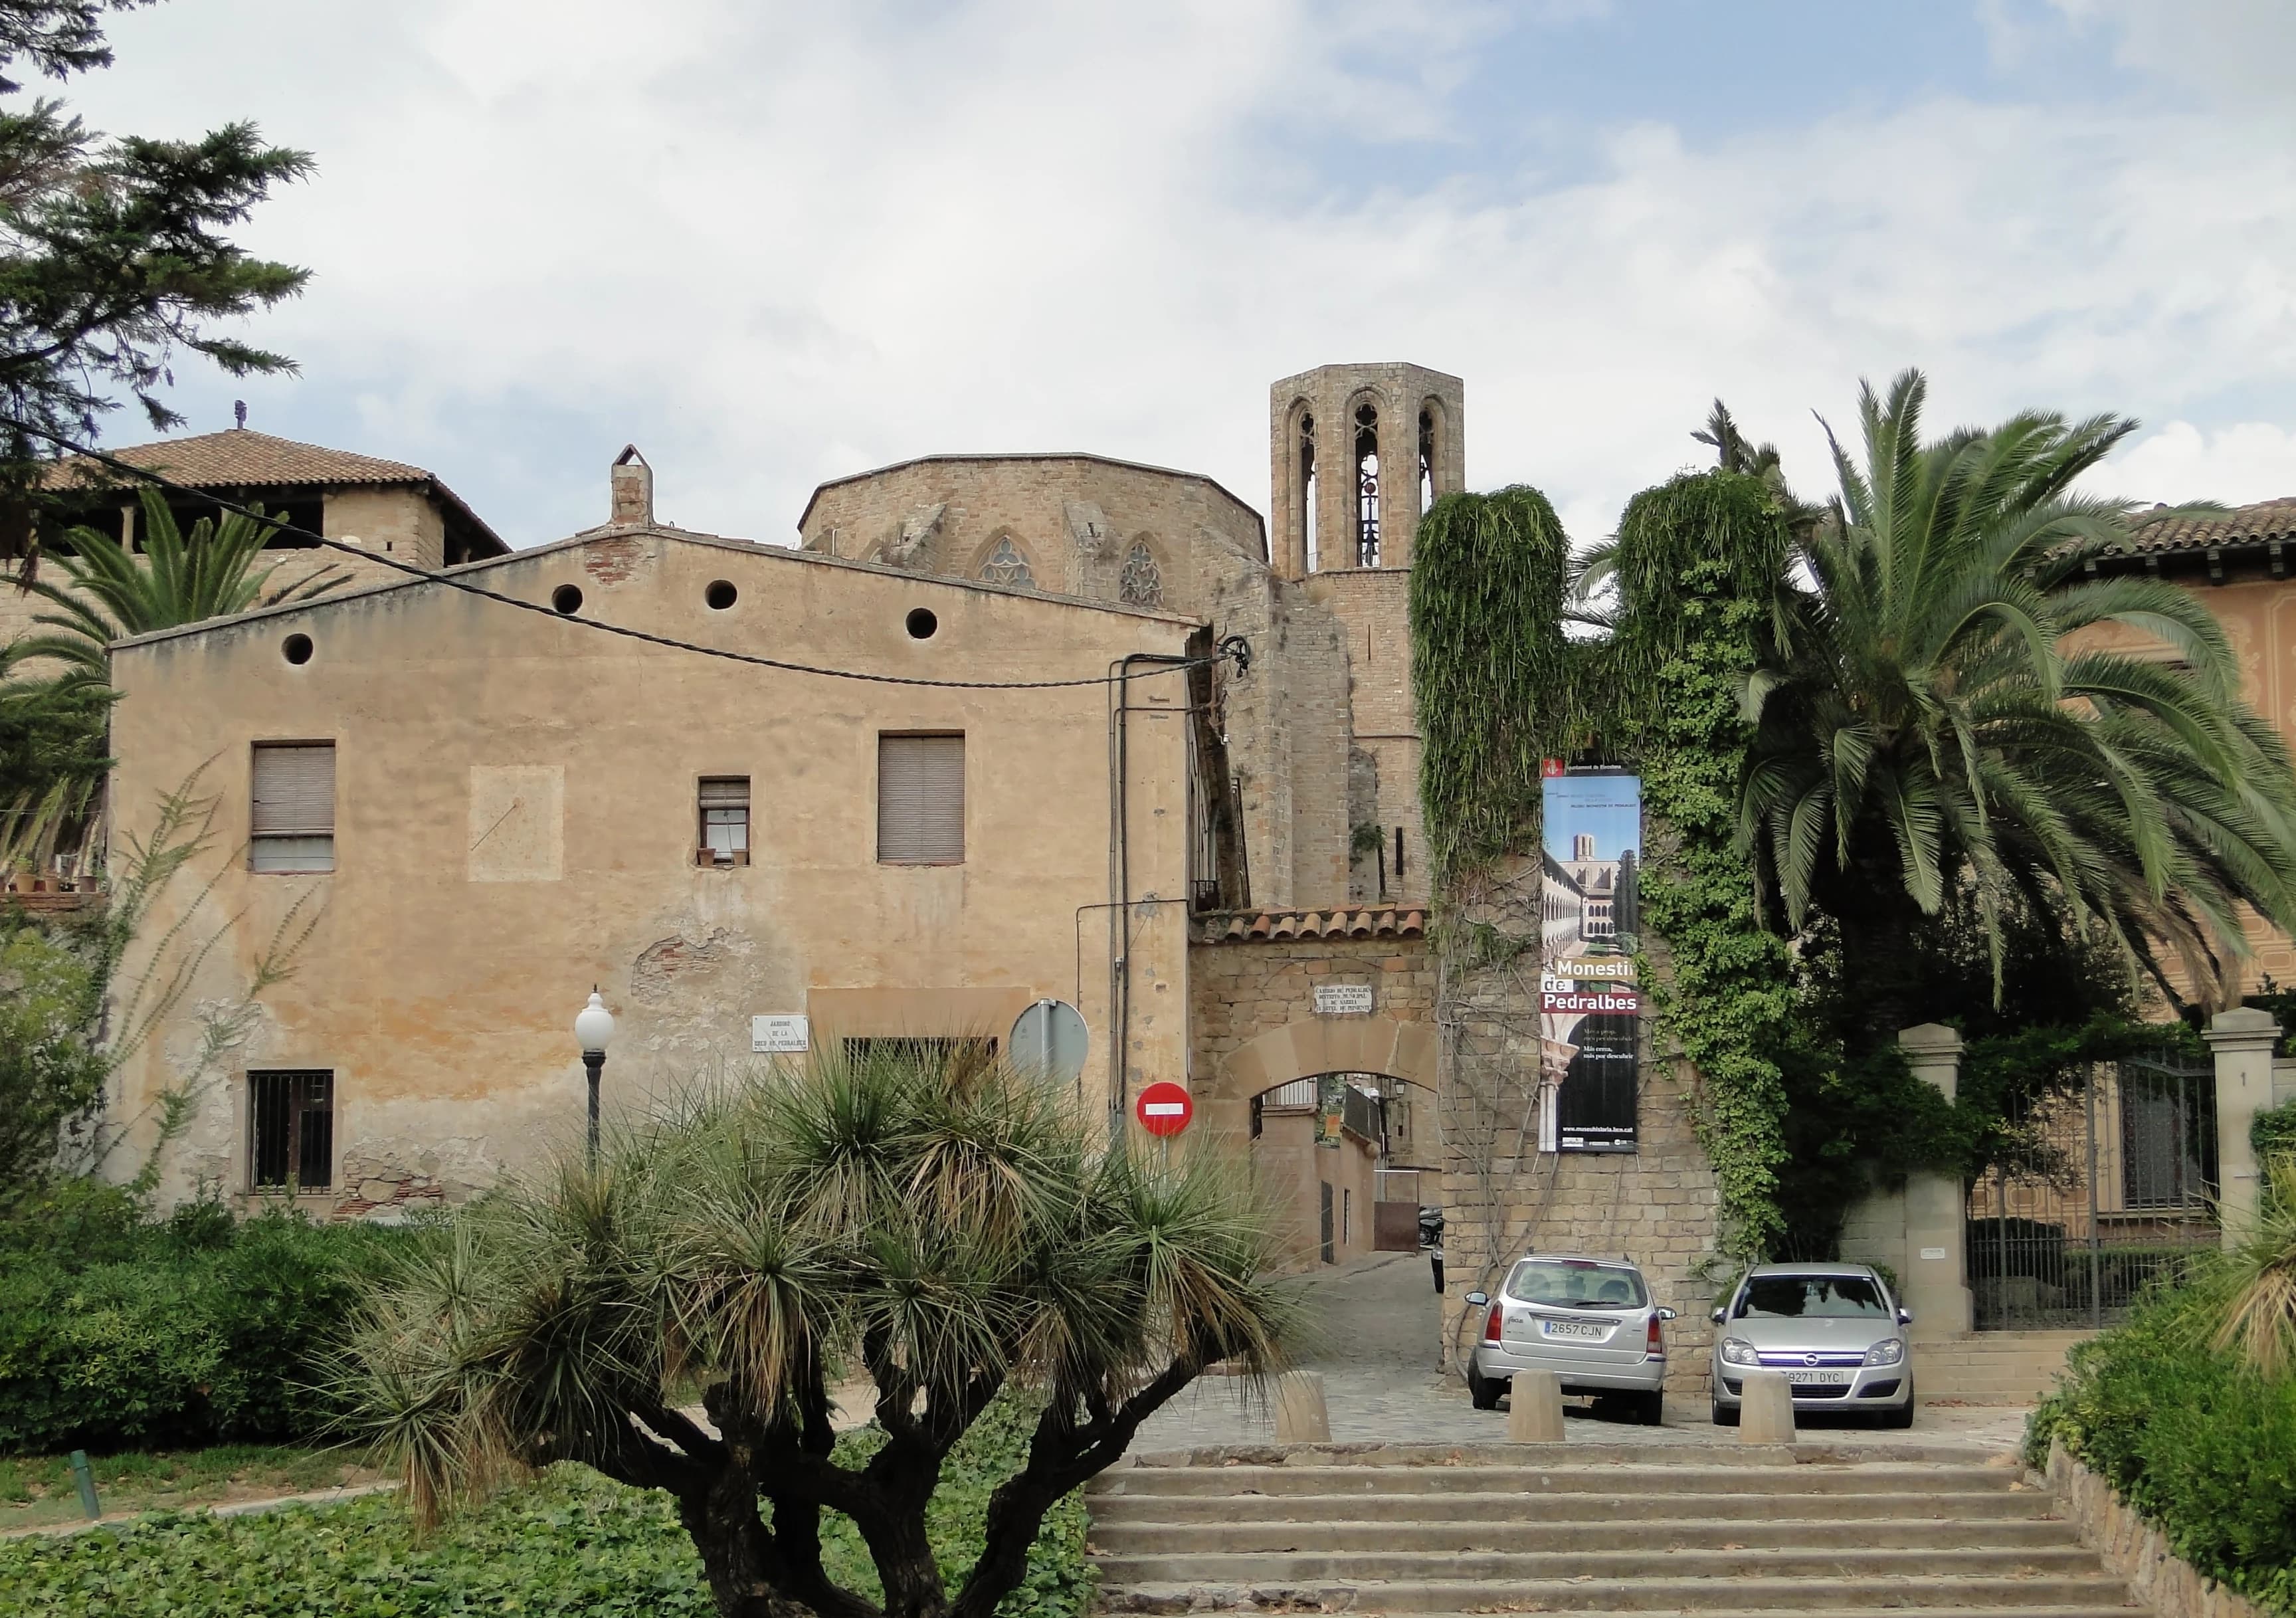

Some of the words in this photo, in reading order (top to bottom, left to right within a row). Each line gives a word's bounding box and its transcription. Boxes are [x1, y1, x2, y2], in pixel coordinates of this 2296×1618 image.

[1545, 977, 1565, 991] de
[1544, 994, 1637, 1010] Pedralbes
[1551, 1323, 1578, 1335] 2657
[1580, 1325, 1602, 1337] CJN
[1788, 1372, 1813, 1383] 9271
[1820, 1372, 1840, 1383] DYC
